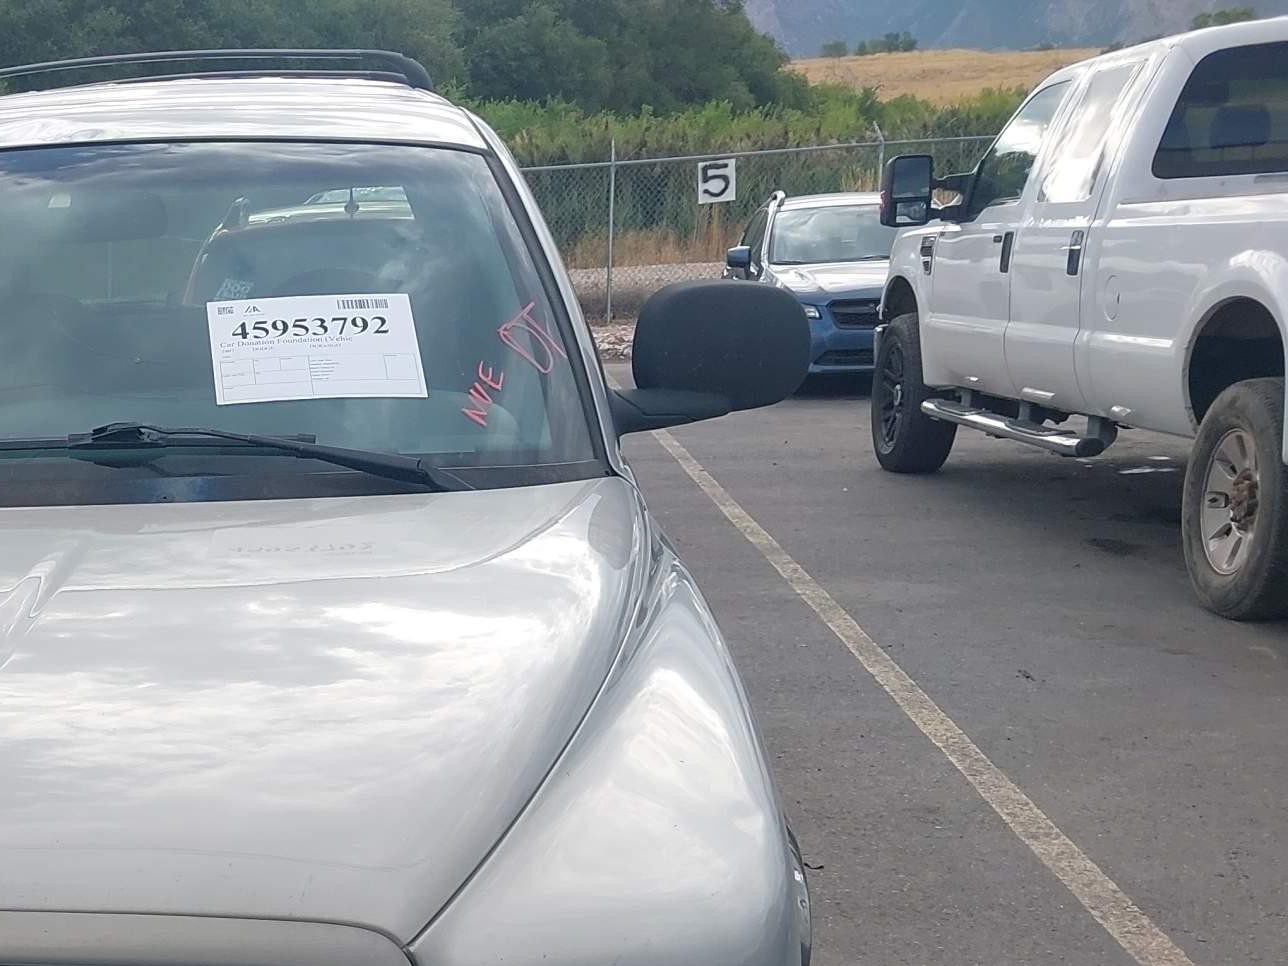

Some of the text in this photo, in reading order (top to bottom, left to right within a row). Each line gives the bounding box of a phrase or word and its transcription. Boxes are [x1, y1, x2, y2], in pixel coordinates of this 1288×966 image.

[702, 163, 730, 198] 5
[231, 316, 390, 340] 45953792
[237, 339, 275, 348] Donation
[277, 336, 323, 345] Foundation
